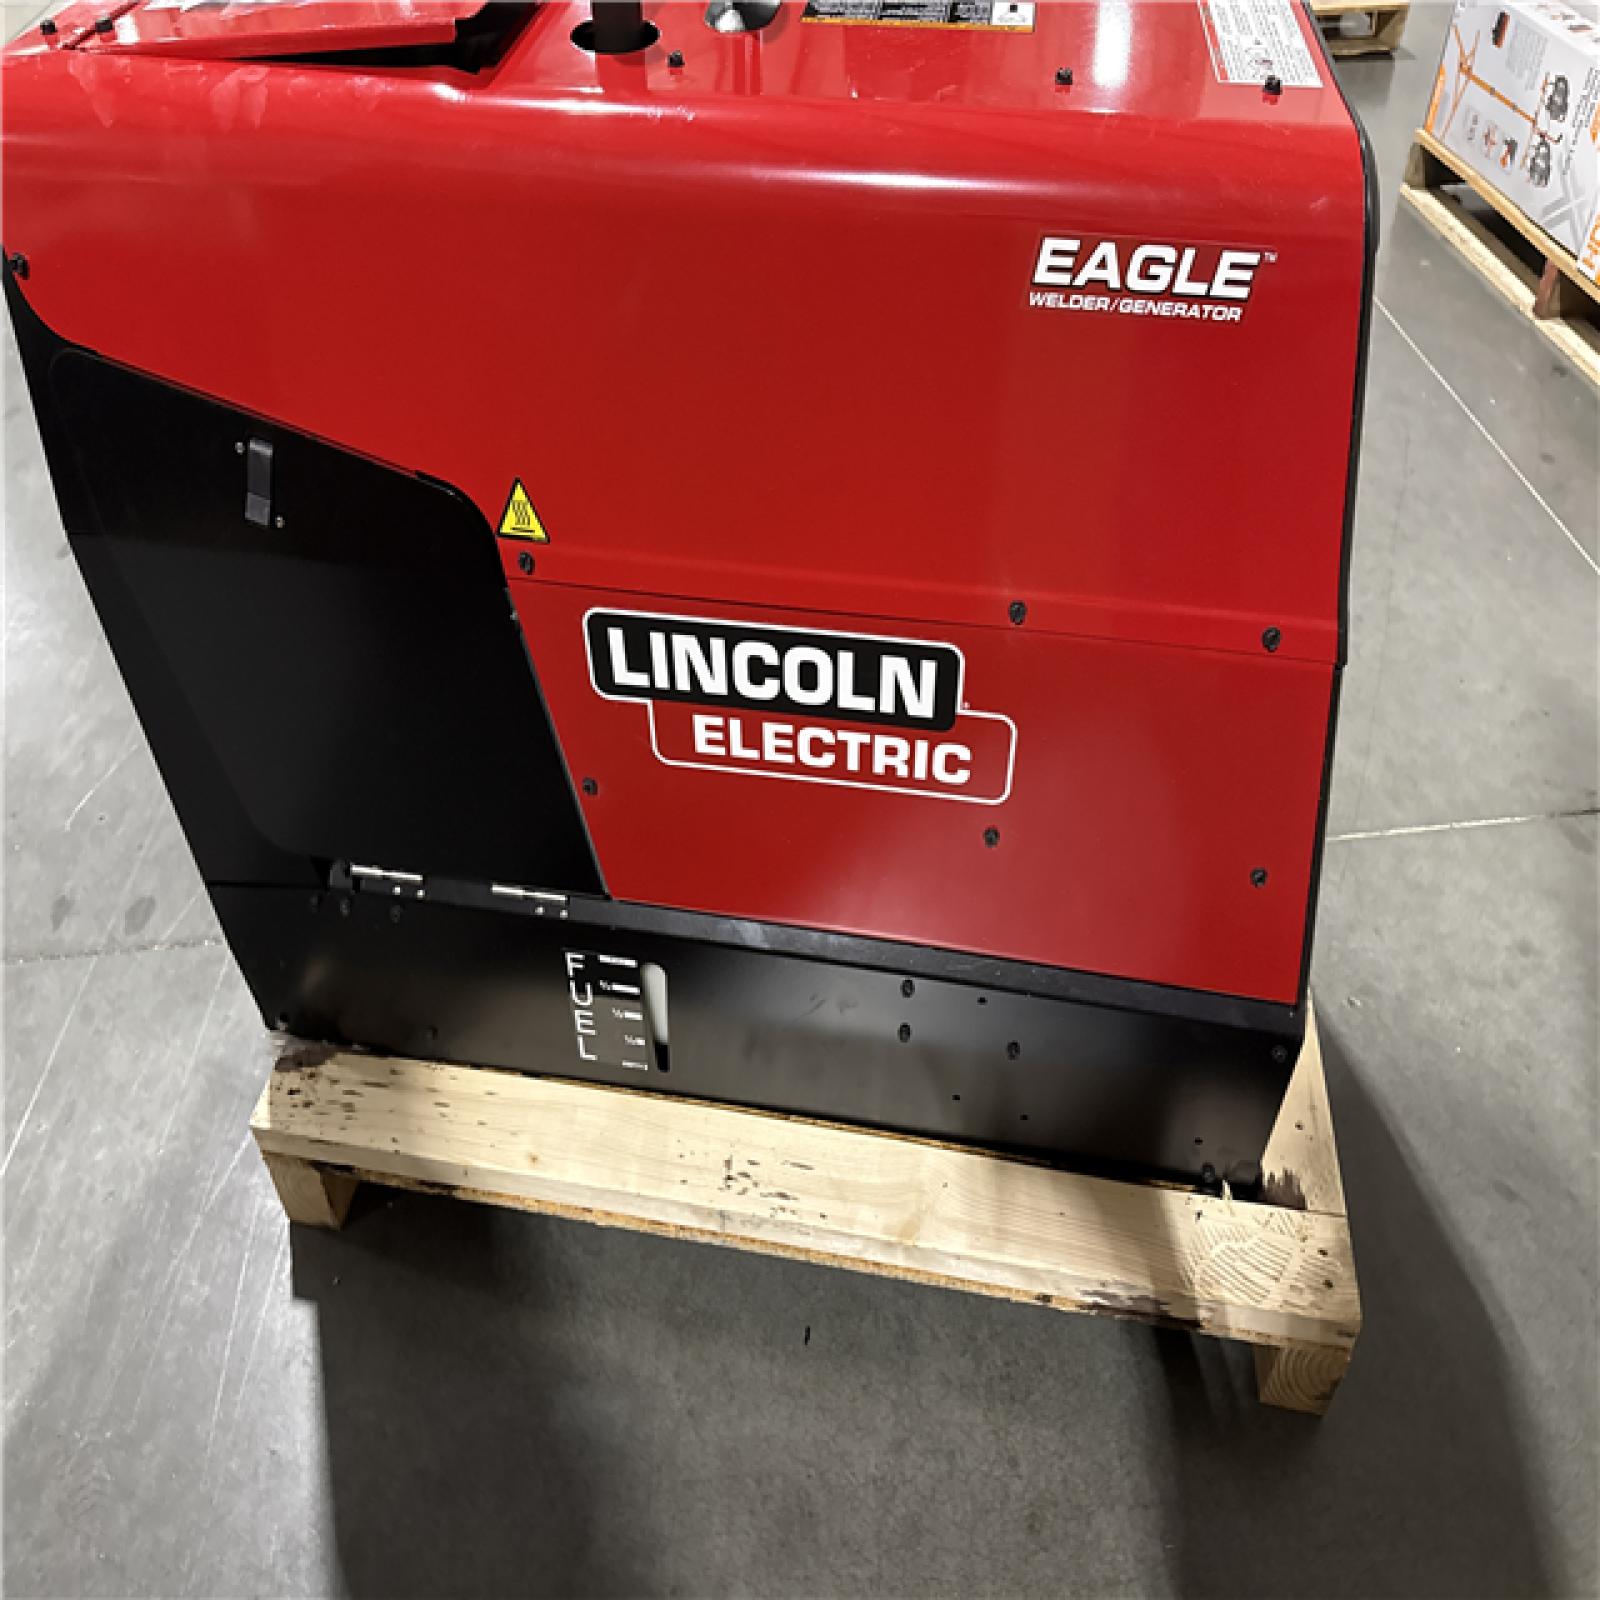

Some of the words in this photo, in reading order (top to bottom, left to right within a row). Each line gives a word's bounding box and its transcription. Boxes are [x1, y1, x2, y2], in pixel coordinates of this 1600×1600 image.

[1031, 236, 1262, 300] EAGLE
[1029, 292, 1243, 322] WELDER/GENERATOR
[606, 626, 940, 719] LINCOLN
[691, 713, 974, 785] ELECTRIC
[564, 952, 599, 1062] FUEL
